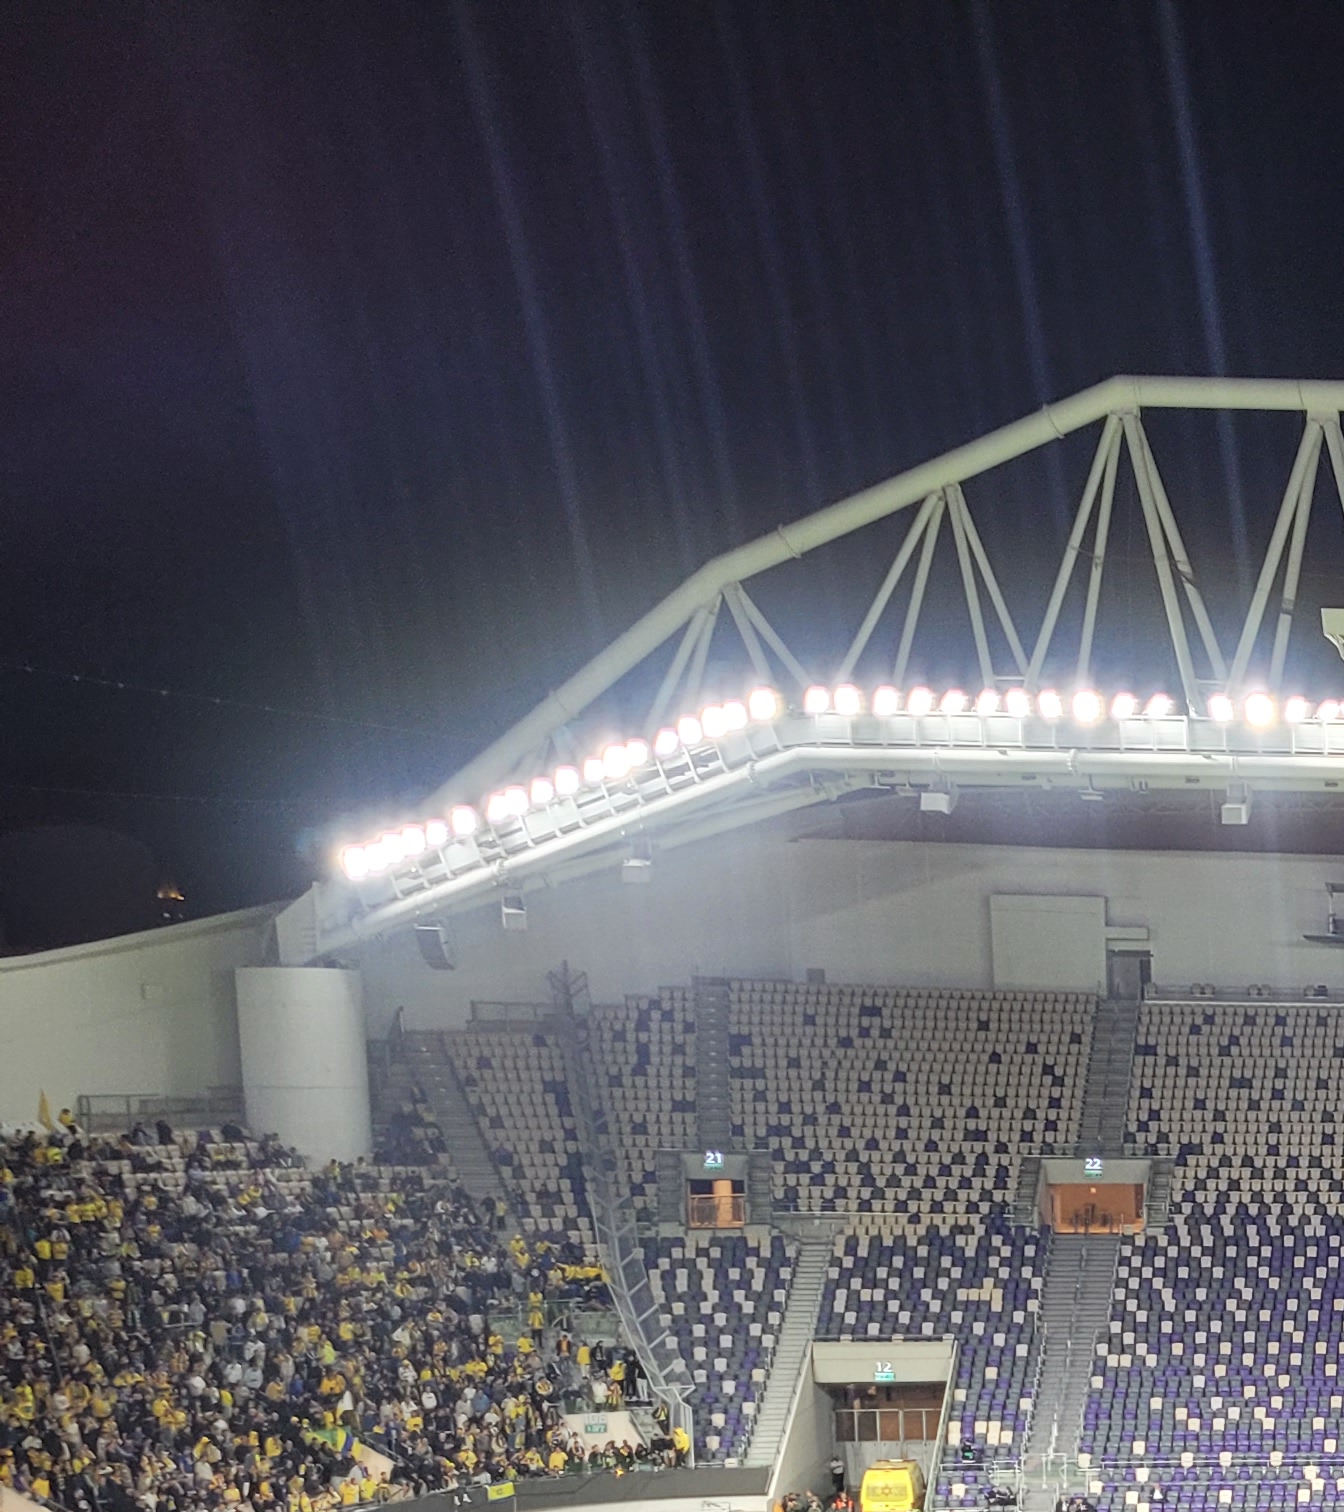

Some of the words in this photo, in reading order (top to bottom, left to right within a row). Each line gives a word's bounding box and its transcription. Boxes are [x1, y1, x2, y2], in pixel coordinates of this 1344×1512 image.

[706, 1153, 723, 1164] 21
[1085, 1158, 1102, 1169] 22
[876, 1362, 893, 1372] 12
